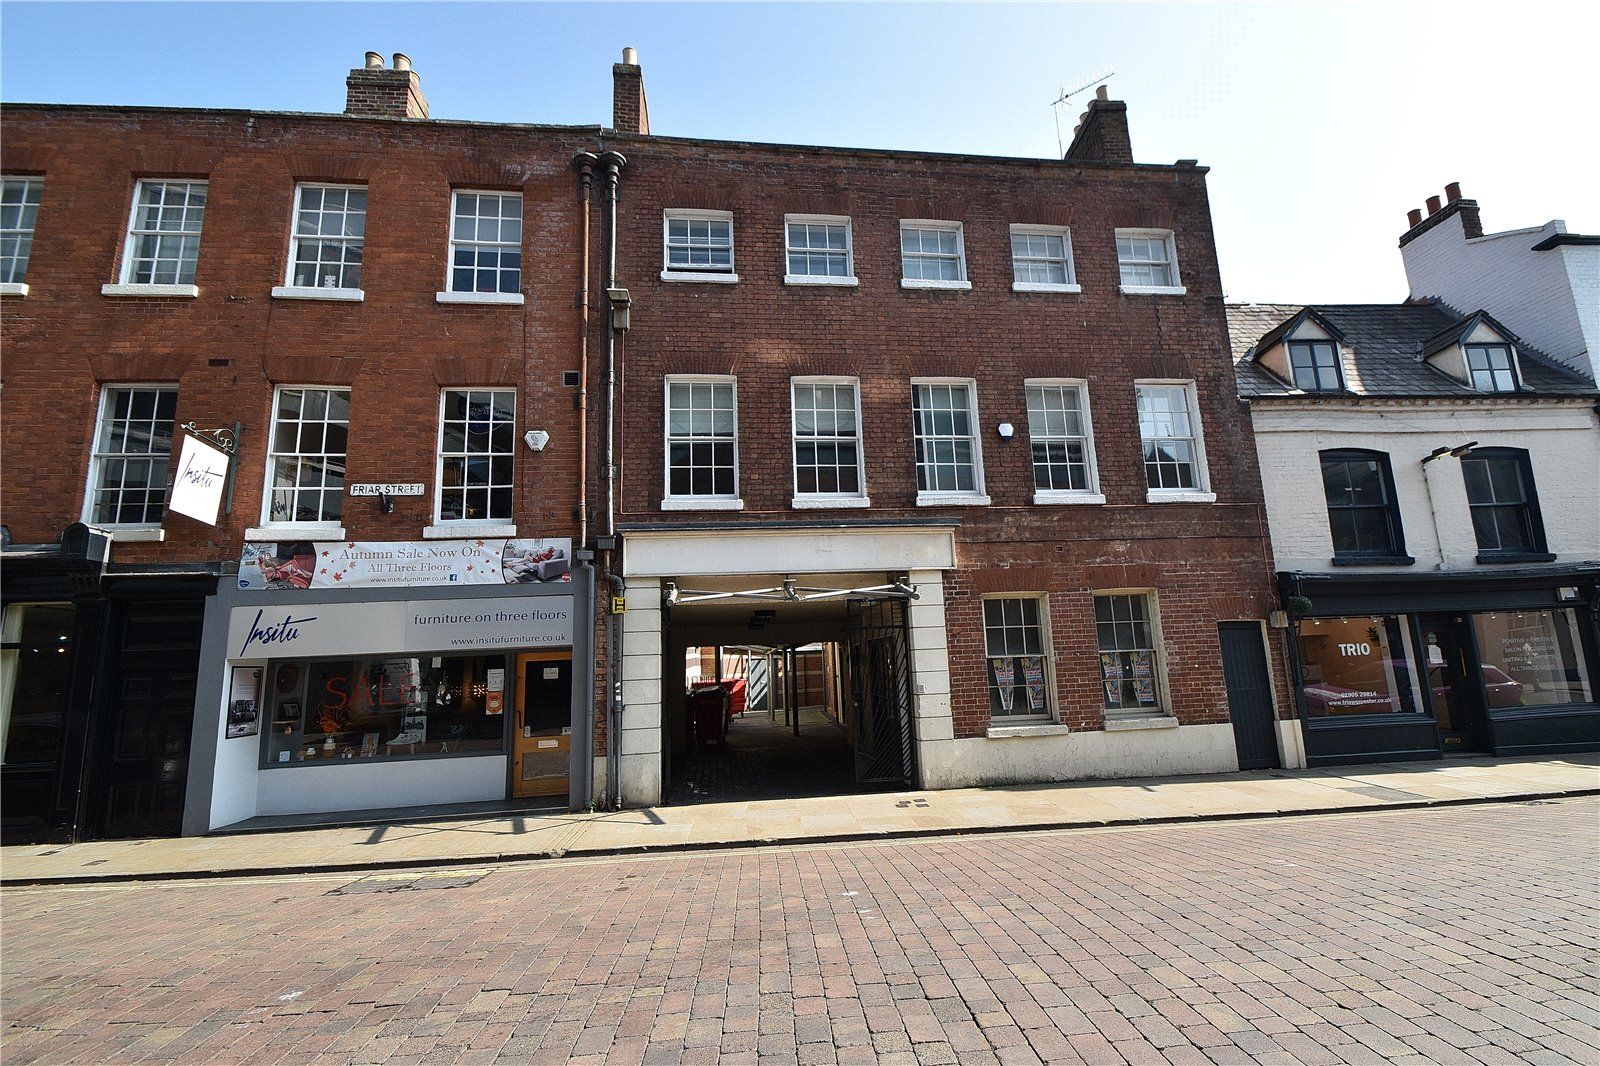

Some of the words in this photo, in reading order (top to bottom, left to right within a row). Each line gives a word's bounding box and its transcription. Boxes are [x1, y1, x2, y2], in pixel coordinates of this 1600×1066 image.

[177, 453, 223, 487] Insitu
[352, 485, 381, 494] FRIAR
[384, 484, 424, 495] STREET
[339, 548, 394, 560] Autumn
[396, 547, 425, 559] Sale
[427, 546, 459, 558] Now
[461, 545, 482, 557] On
[367, 562, 384, 573] All
[385, 562, 419, 573] Three
[420, 561, 452, 572] Floors
[369, 574, 448, 585] www.insitufurniture.co.uk
[614, 598, 626, 611] H
[414, 613, 471, 625] furniture
[474, 613, 492, 622] on
[495, 610, 529, 622] three
[531, 609, 567, 620] floors
[239, 608, 318, 657] Insitu
[450, 633, 566, 646] www.insitufurniture.co.uk
[1338, 643, 1371, 656] TRIO
[325, 672, 415, 710] SALE
